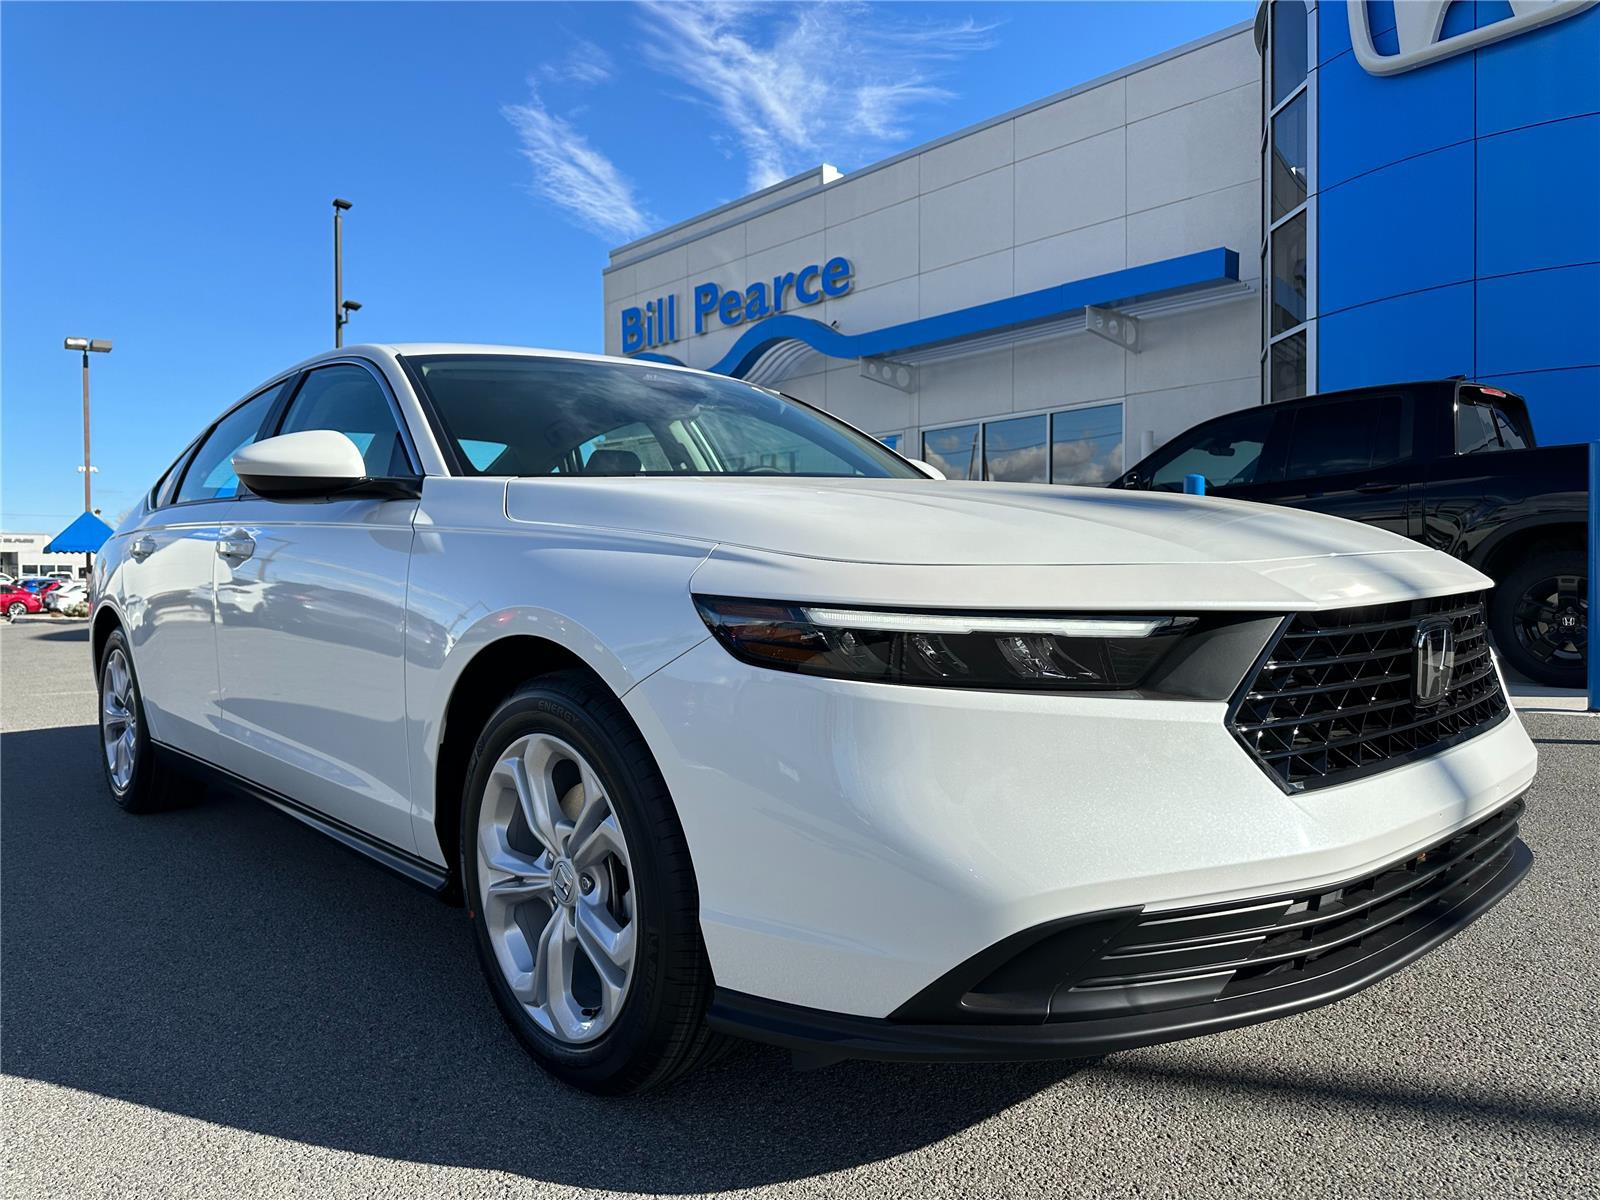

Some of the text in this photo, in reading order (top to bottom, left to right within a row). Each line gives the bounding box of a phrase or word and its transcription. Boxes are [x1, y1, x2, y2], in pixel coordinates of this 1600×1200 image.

[621, 256, 852, 354] Bill Pearce
[538, 700, 580, 722] ENERGY
